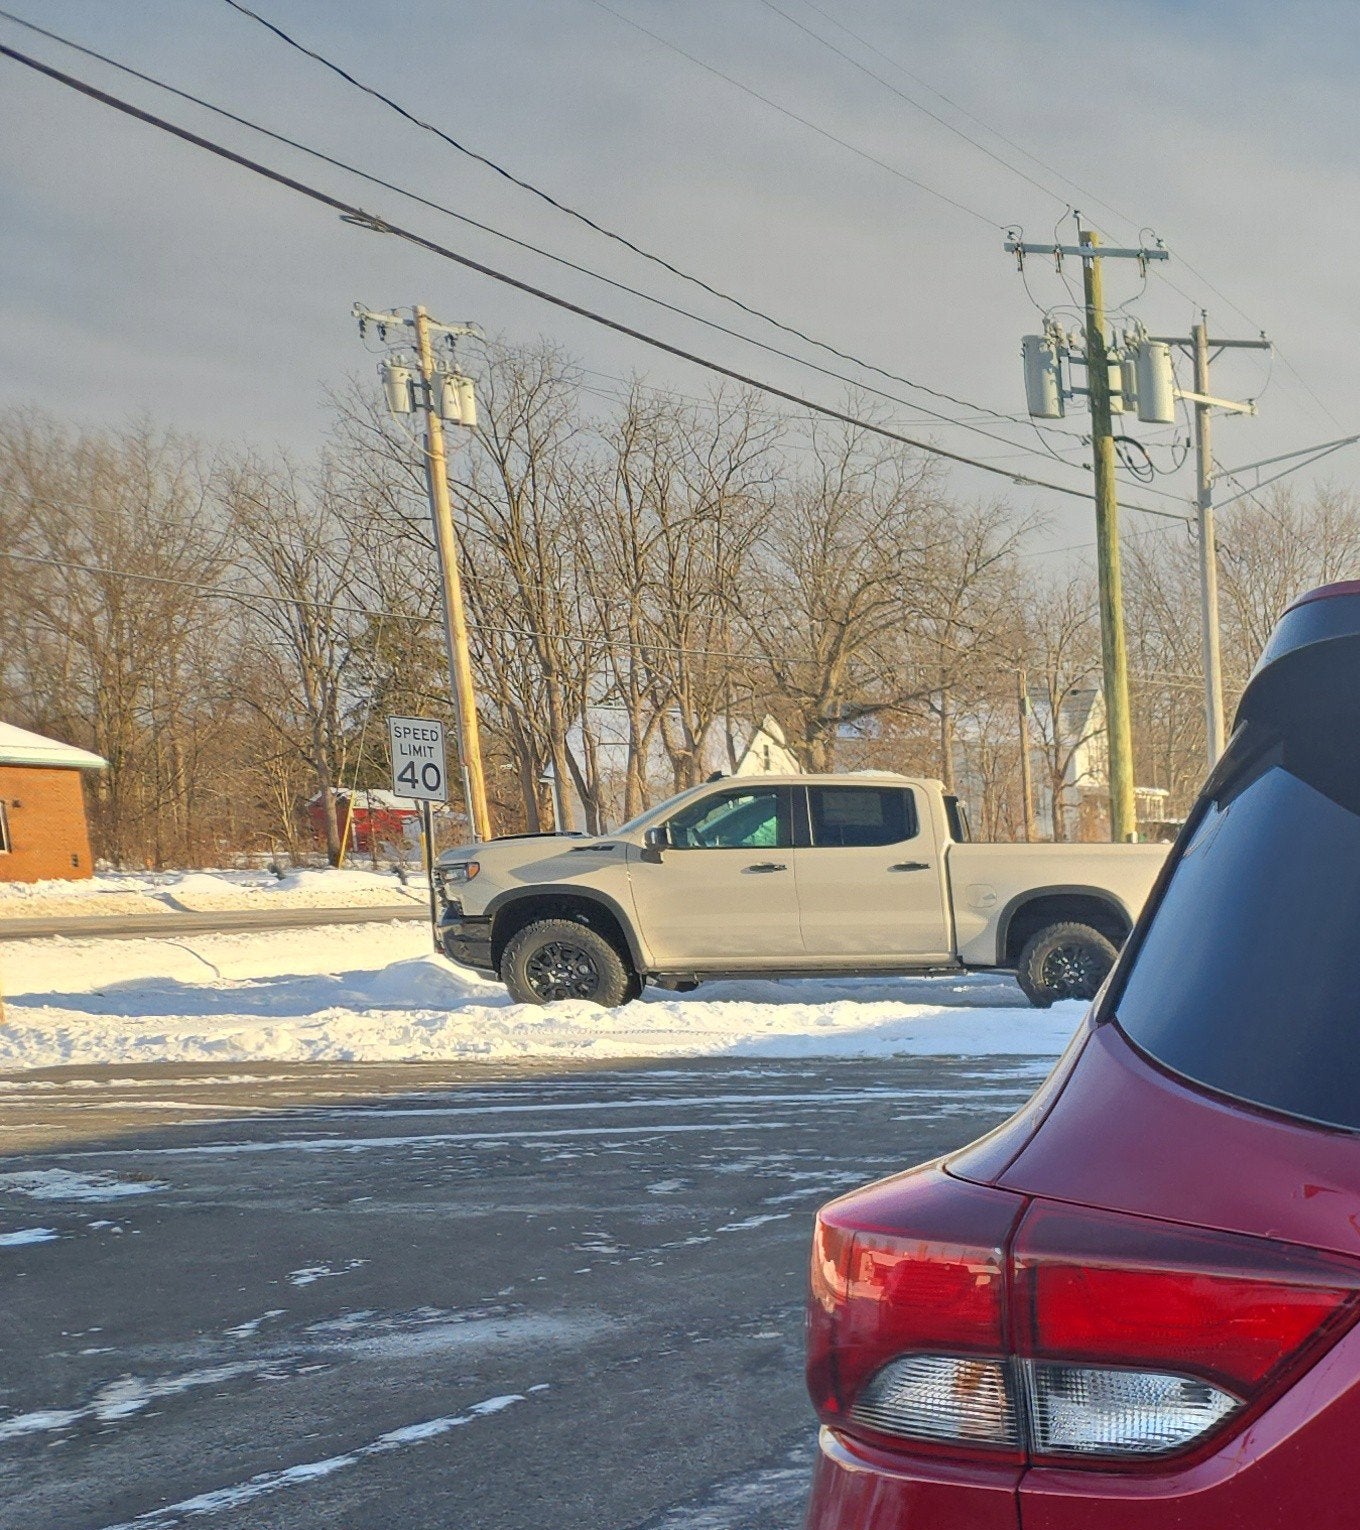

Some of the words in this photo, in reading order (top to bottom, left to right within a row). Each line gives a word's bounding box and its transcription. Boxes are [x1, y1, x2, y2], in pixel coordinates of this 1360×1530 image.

[394, 725, 439, 742] SPEED
[400, 743, 434, 759] LIMIT
[397, 760, 441, 792] 40
